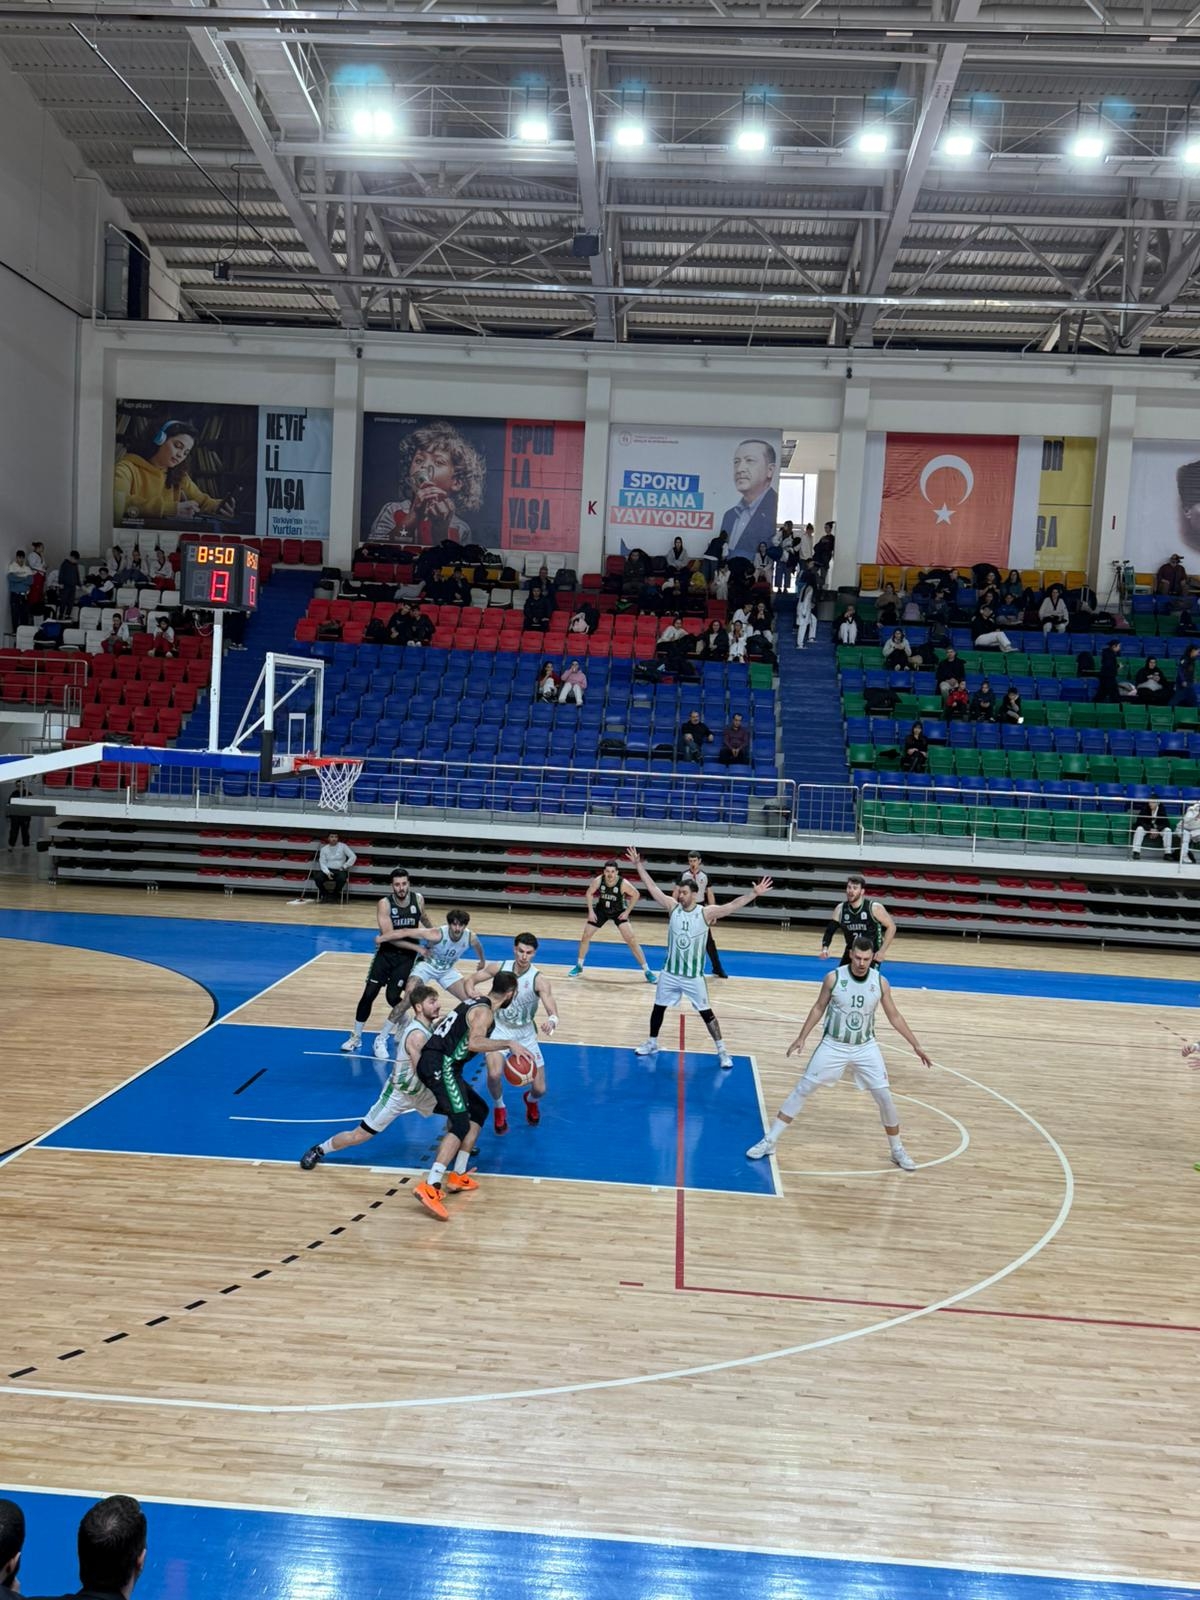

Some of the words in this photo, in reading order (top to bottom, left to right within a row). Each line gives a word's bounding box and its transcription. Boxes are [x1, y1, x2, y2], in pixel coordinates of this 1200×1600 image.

[511, 458, 530, 488] LA
[630, 473, 689, 491] SPORU
[265, 478, 304, 513] YAŞA
[624, 492, 696, 508] TABANA
[508, 497, 550, 533] YAŞA
[588, 501, 597, 515] K
[613, 507, 711, 528] YAYIYORUZ
[198, 546, 235, 565] 8:50
[211, 571, 229, 601] 8
[682, 921, 689, 931] 11
[851, 995, 865, 1008] 19
